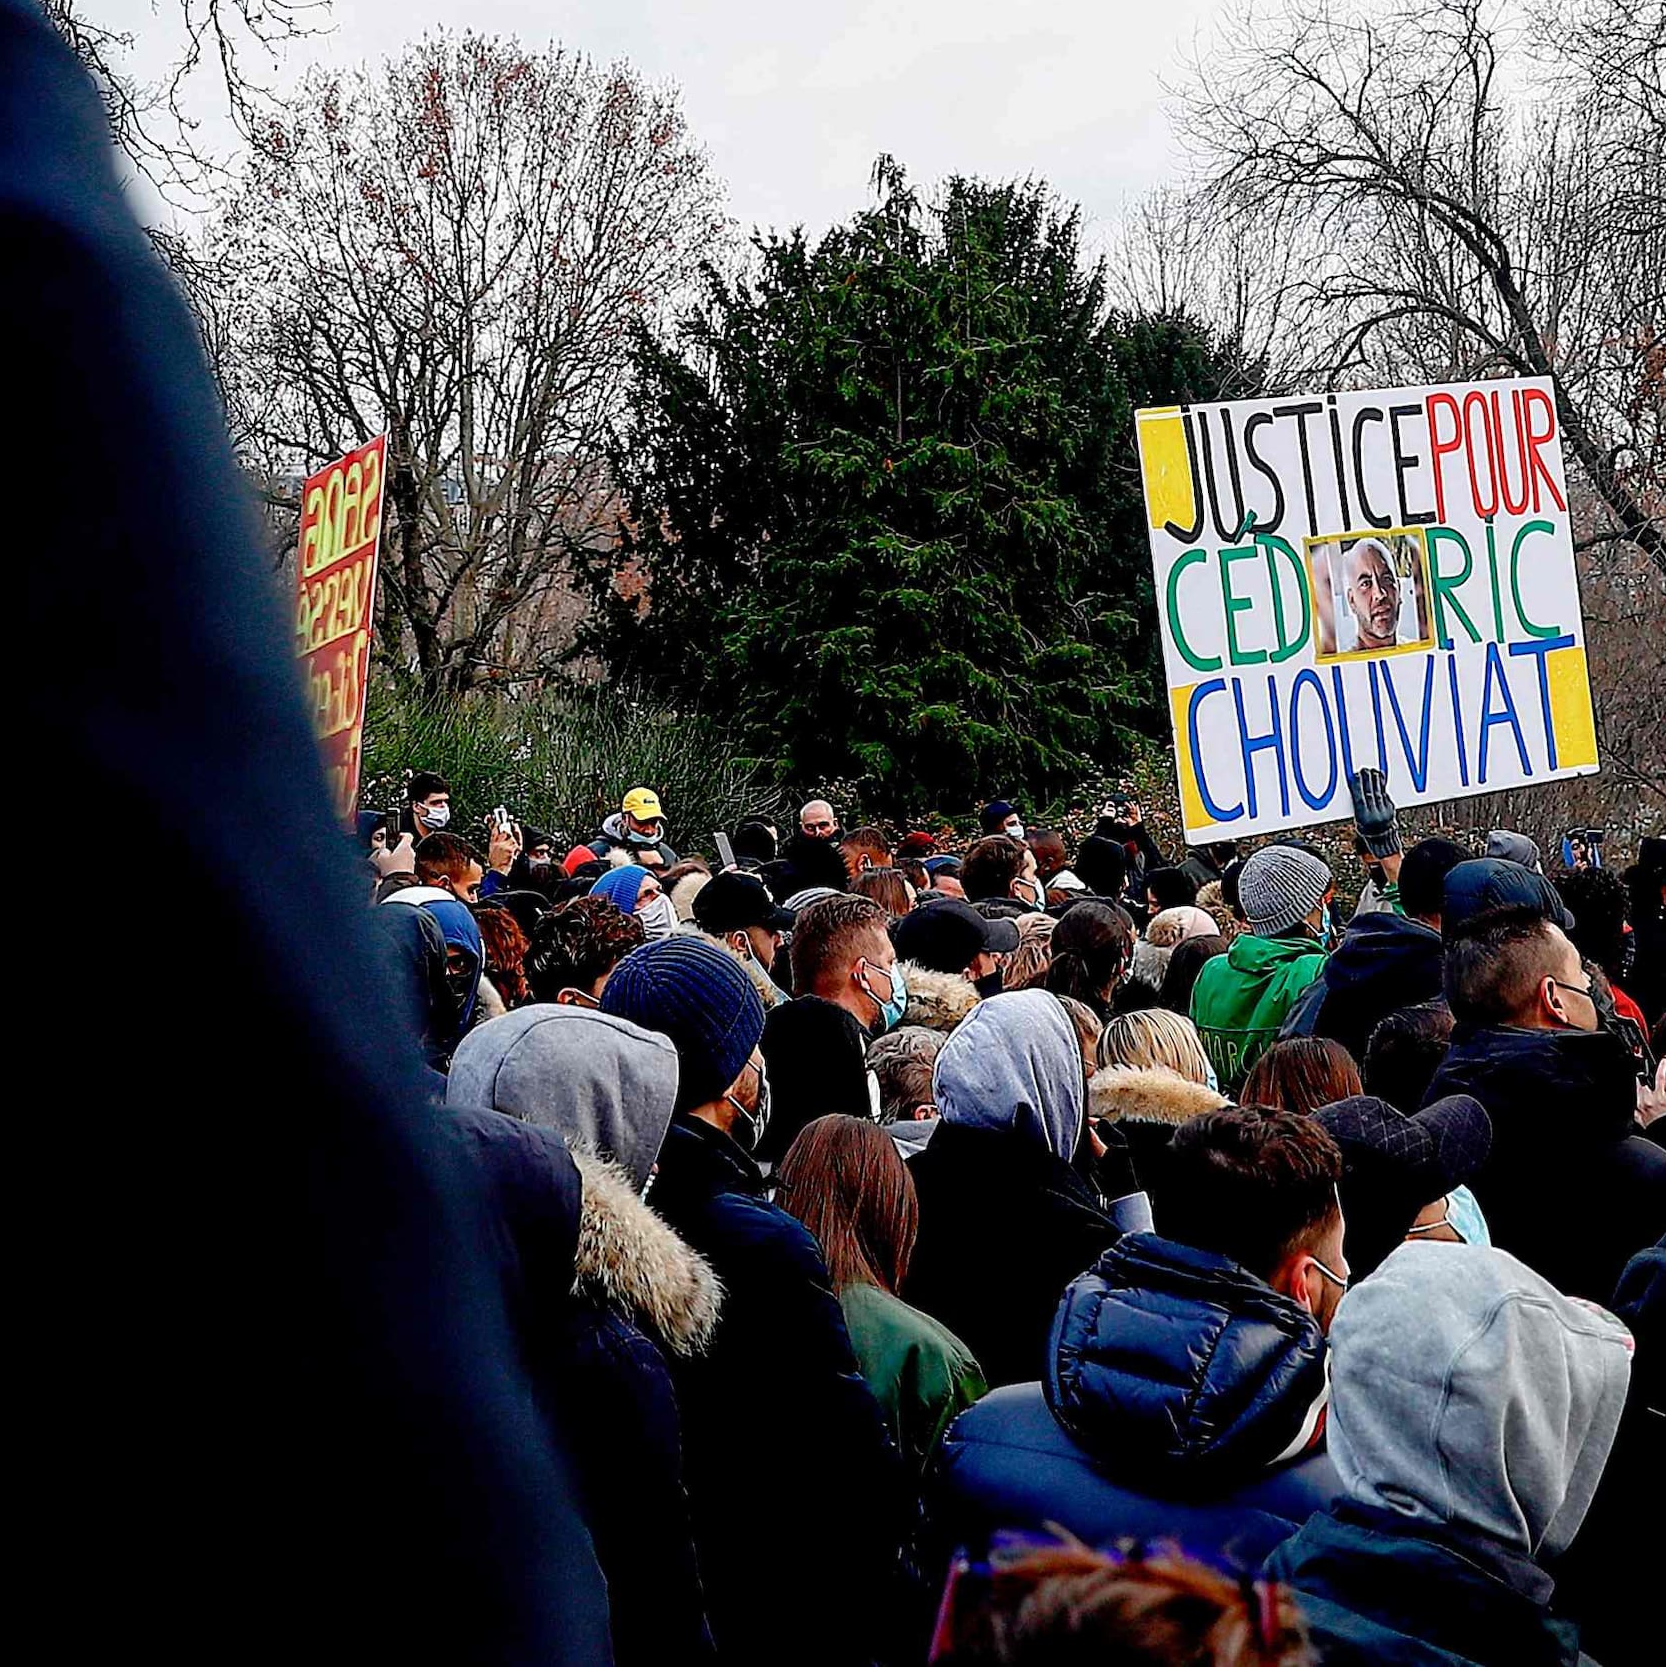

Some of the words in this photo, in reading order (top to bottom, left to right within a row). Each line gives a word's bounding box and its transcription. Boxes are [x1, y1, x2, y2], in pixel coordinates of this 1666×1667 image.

[1165, 394, 1435, 543] JUSTICE
[1428, 388, 1566, 524] POUR
[1188, 635, 1575, 823] CHOUVIAT
